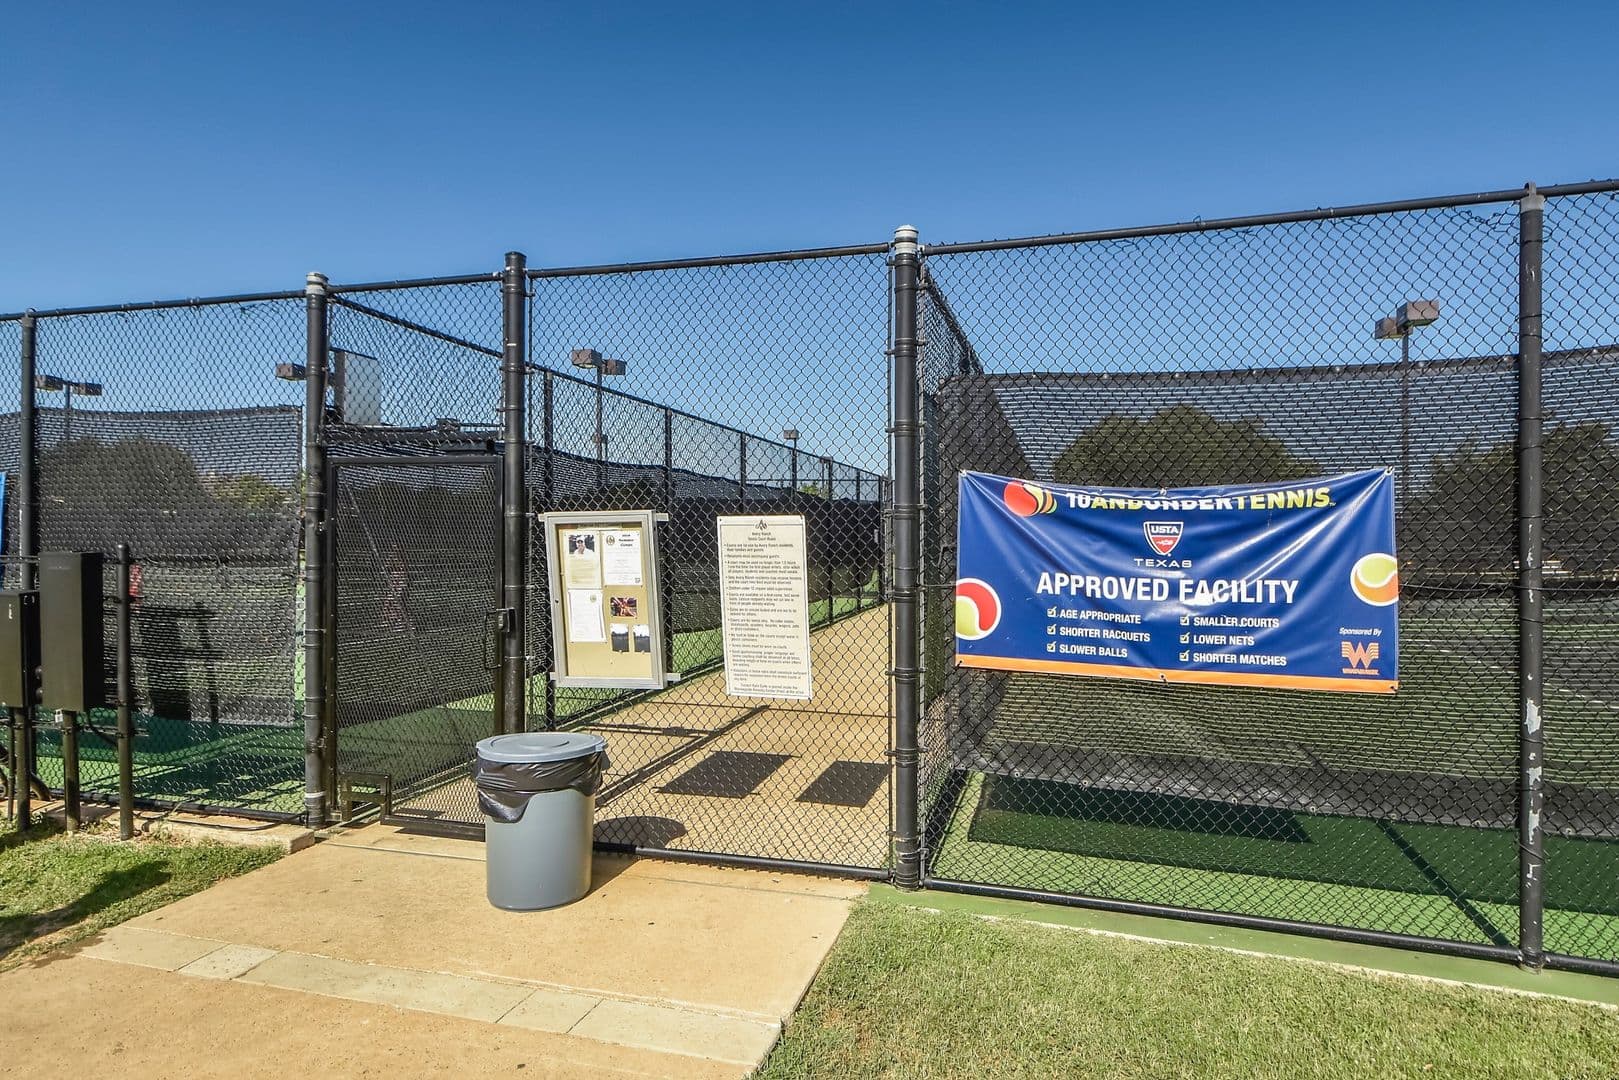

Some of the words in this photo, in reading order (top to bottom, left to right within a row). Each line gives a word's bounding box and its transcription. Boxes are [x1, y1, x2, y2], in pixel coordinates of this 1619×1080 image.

[1150, 524, 1179, 536] USTA
[1134, 558, 1193, 569] TEXAS
[1036, 572, 1169, 602] APPROVED
[1179, 579, 1299, 605] FACILITY
[1059, 609, 1078, 619] AGE
[1080, 610, 1141, 625] APPROPRIATE
[1193, 616, 1237, 627] SMALLER
[1240, 617, 1280, 628] COURTS
[1059, 626, 1101, 638] SHORTER
[1102, 629, 1151, 643] RACQUETS
[1339, 627, 1373, 636] Sponsored
[1373, 628, 1383, 637] By
[1193, 634, 1227, 646] LOWER
[1229, 635, 1255, 646] NETS
[1059, 644, 1097, 656] SLOWER
[1098, 646, 1128, 658] BALLS
[1193, 652, 1237, 664] SHORTER
[1239, 654, 1287, 666] MATCHES
